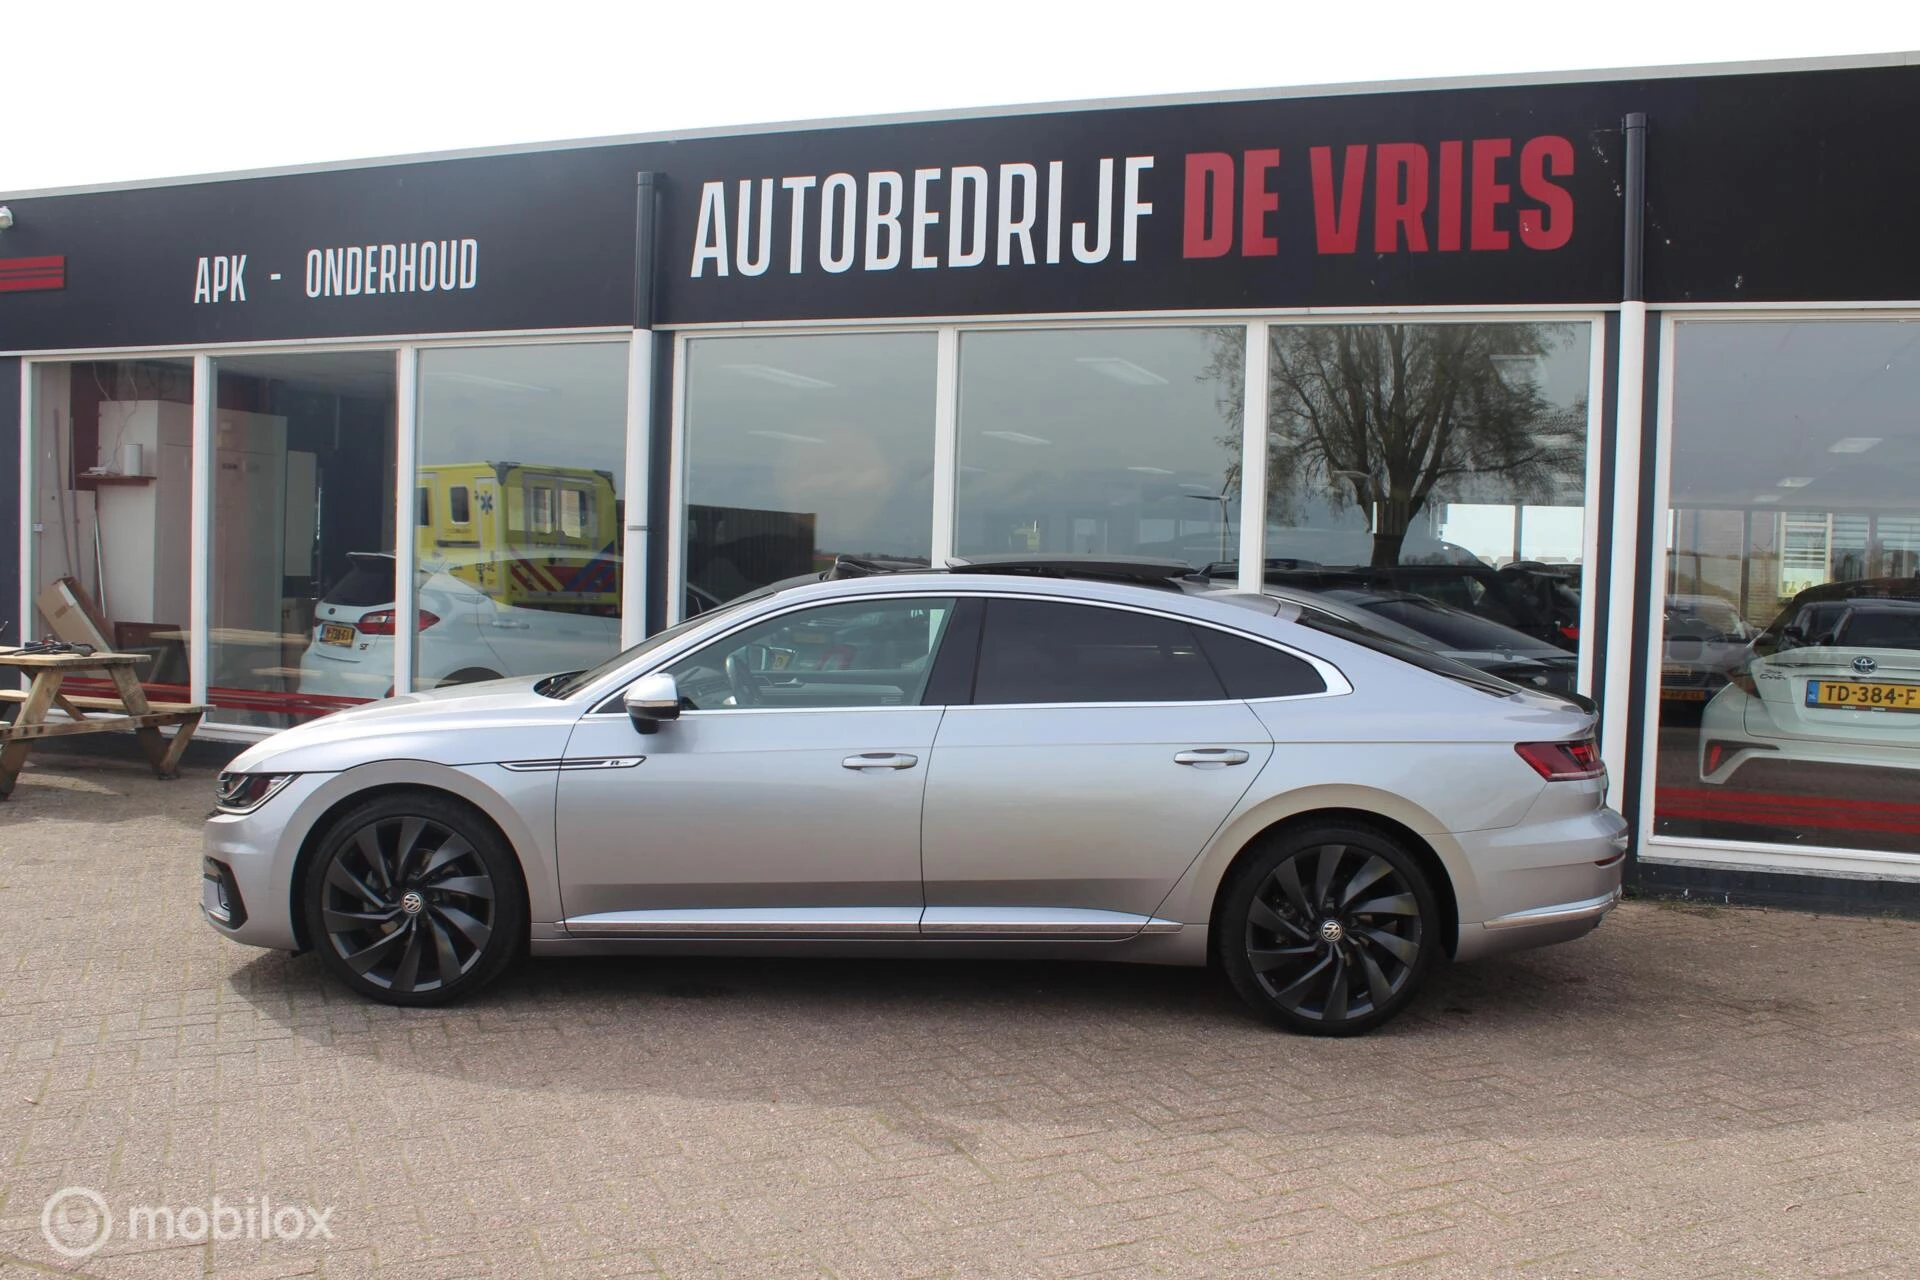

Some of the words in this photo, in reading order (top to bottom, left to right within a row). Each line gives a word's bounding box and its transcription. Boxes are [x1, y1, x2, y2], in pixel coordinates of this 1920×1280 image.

[690, 155, 1155, 278] AUTOBEDRIJF
[1182, 148, 1280, 259] DE
[1309, 135, 1575, 255] VRIES
[193, 254, 248, 304] APK
[305, 238, 479, 298] ONDERHOUD
[1825, 685, 1917, 705] TD-384-F
